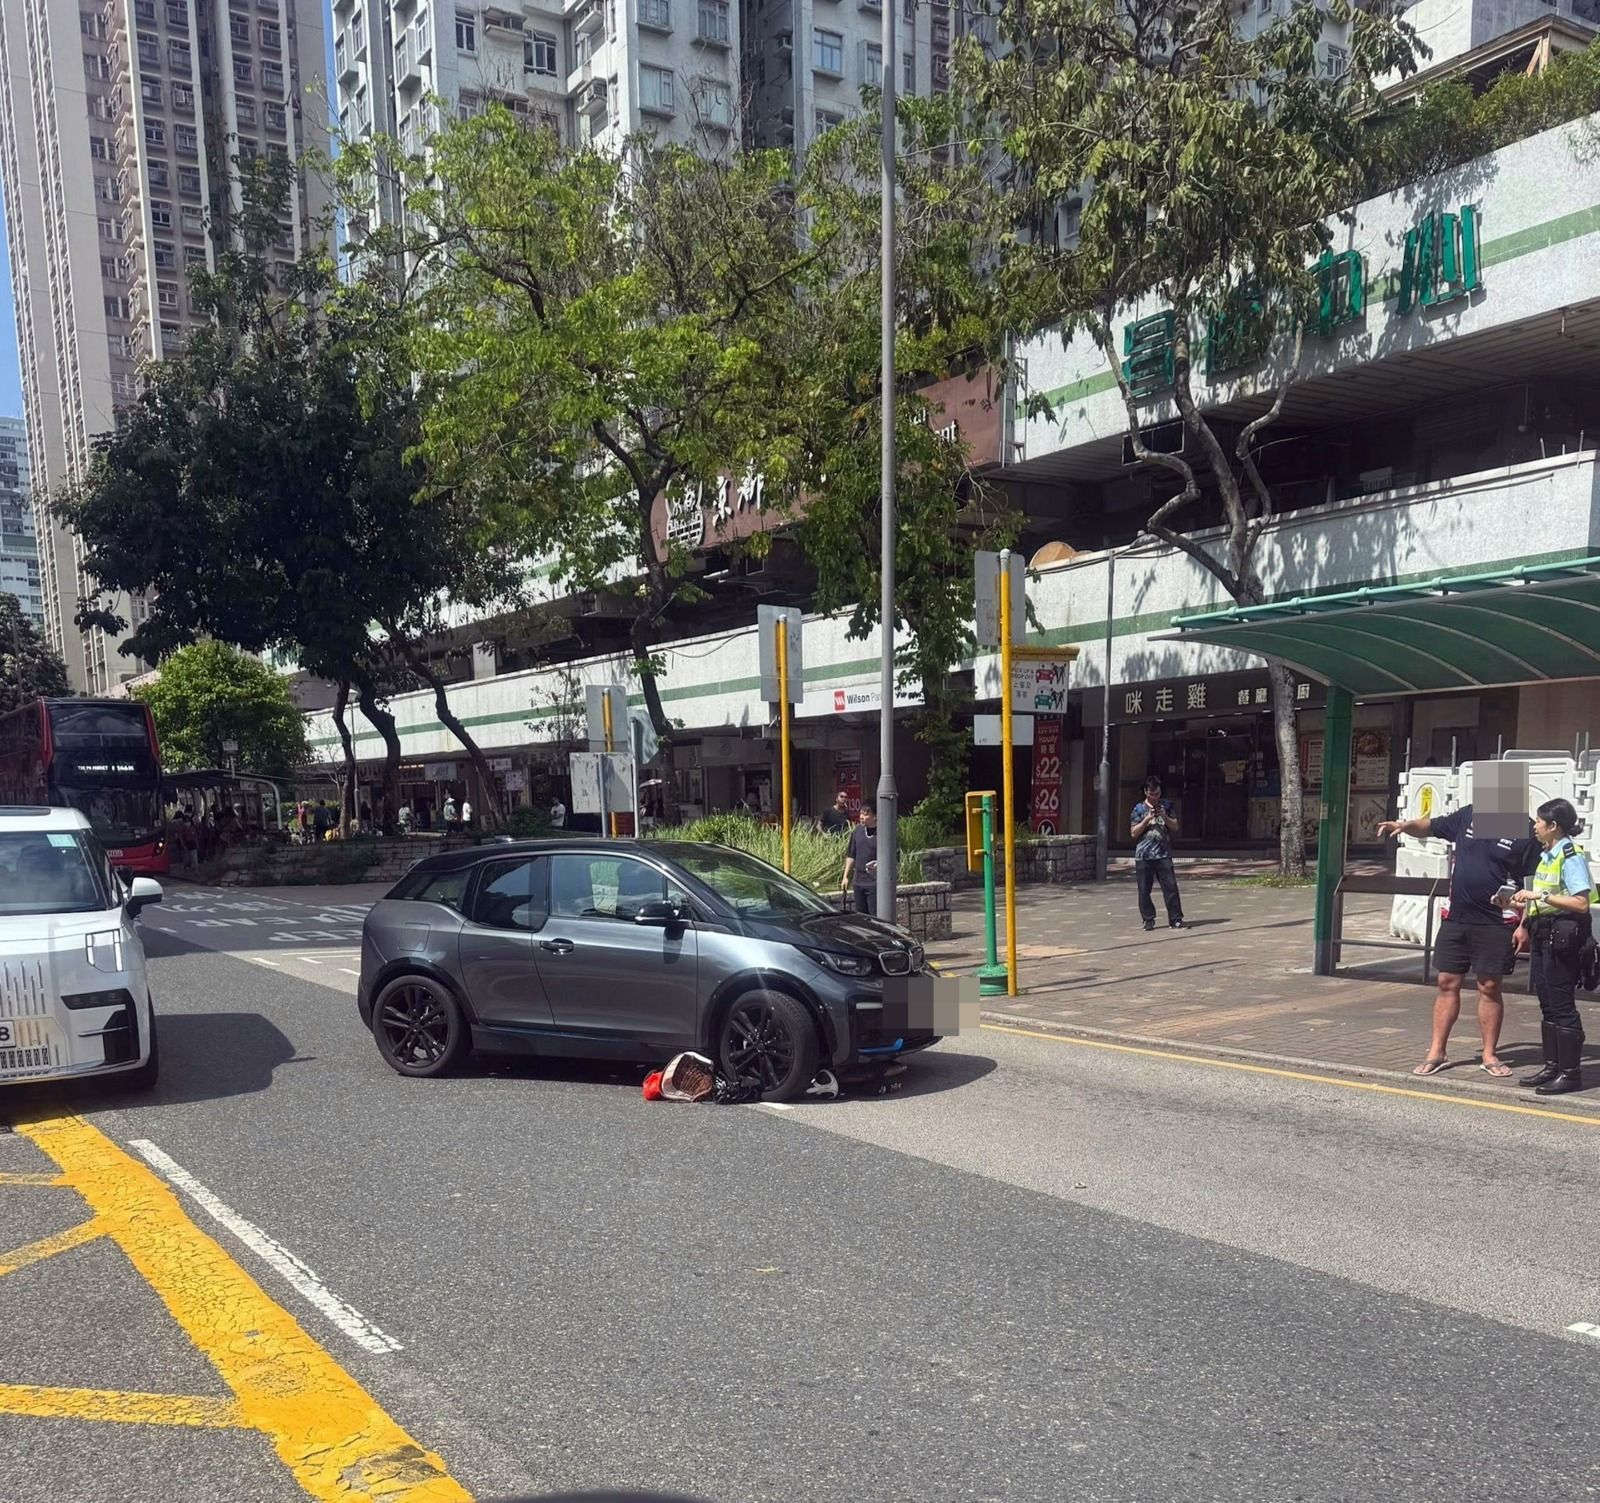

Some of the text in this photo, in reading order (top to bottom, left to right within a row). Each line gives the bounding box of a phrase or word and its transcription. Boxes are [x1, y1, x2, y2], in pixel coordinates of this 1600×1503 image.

[847, 692, 870, 704] Wilson
[1125, 683, 1207, 715] 咪走雞
[1035, 756, 1060, 779] $22
[1035, 788, 1060, 811] $26
